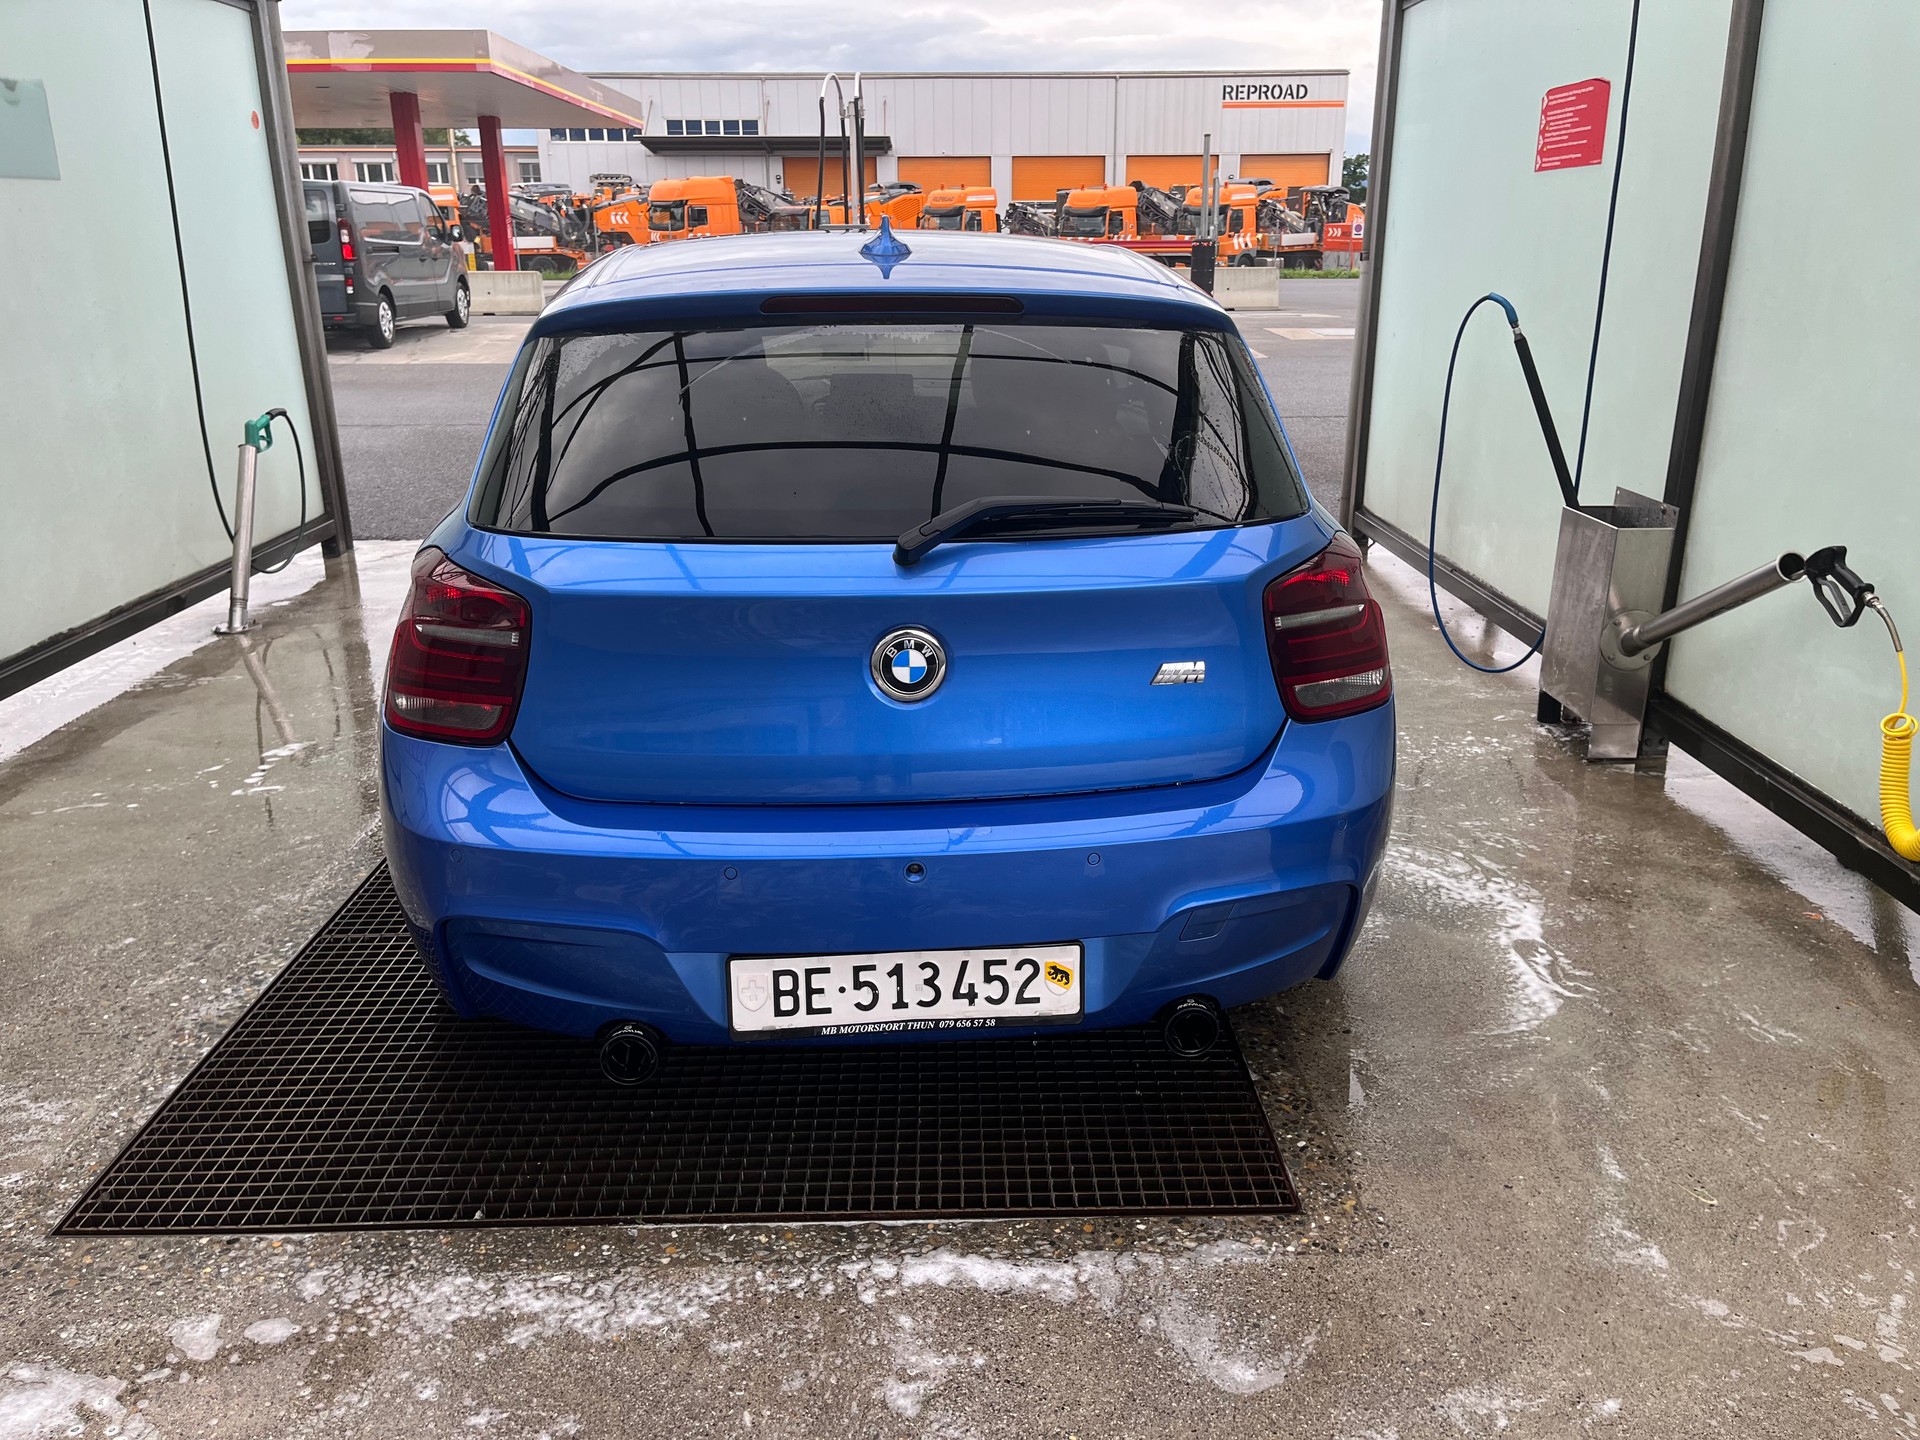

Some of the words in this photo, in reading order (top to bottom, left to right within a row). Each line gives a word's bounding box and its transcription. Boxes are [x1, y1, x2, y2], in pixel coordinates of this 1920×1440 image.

[1222, 84, 1308, 100] REPROAD
[886, 639, 934, 659] BMW
[821, 1027, 837, 1035] MB
[838, 1022, 906, 1034] MOTORSPORT
[907, 1020, 935, 1030] THUN
[939, 1019, 955, 1028] 079
[956, 1019, 972, 1028] 656
[973, 1018, 983, 1027] 57
[985, 1018, 996, 1027] 58
